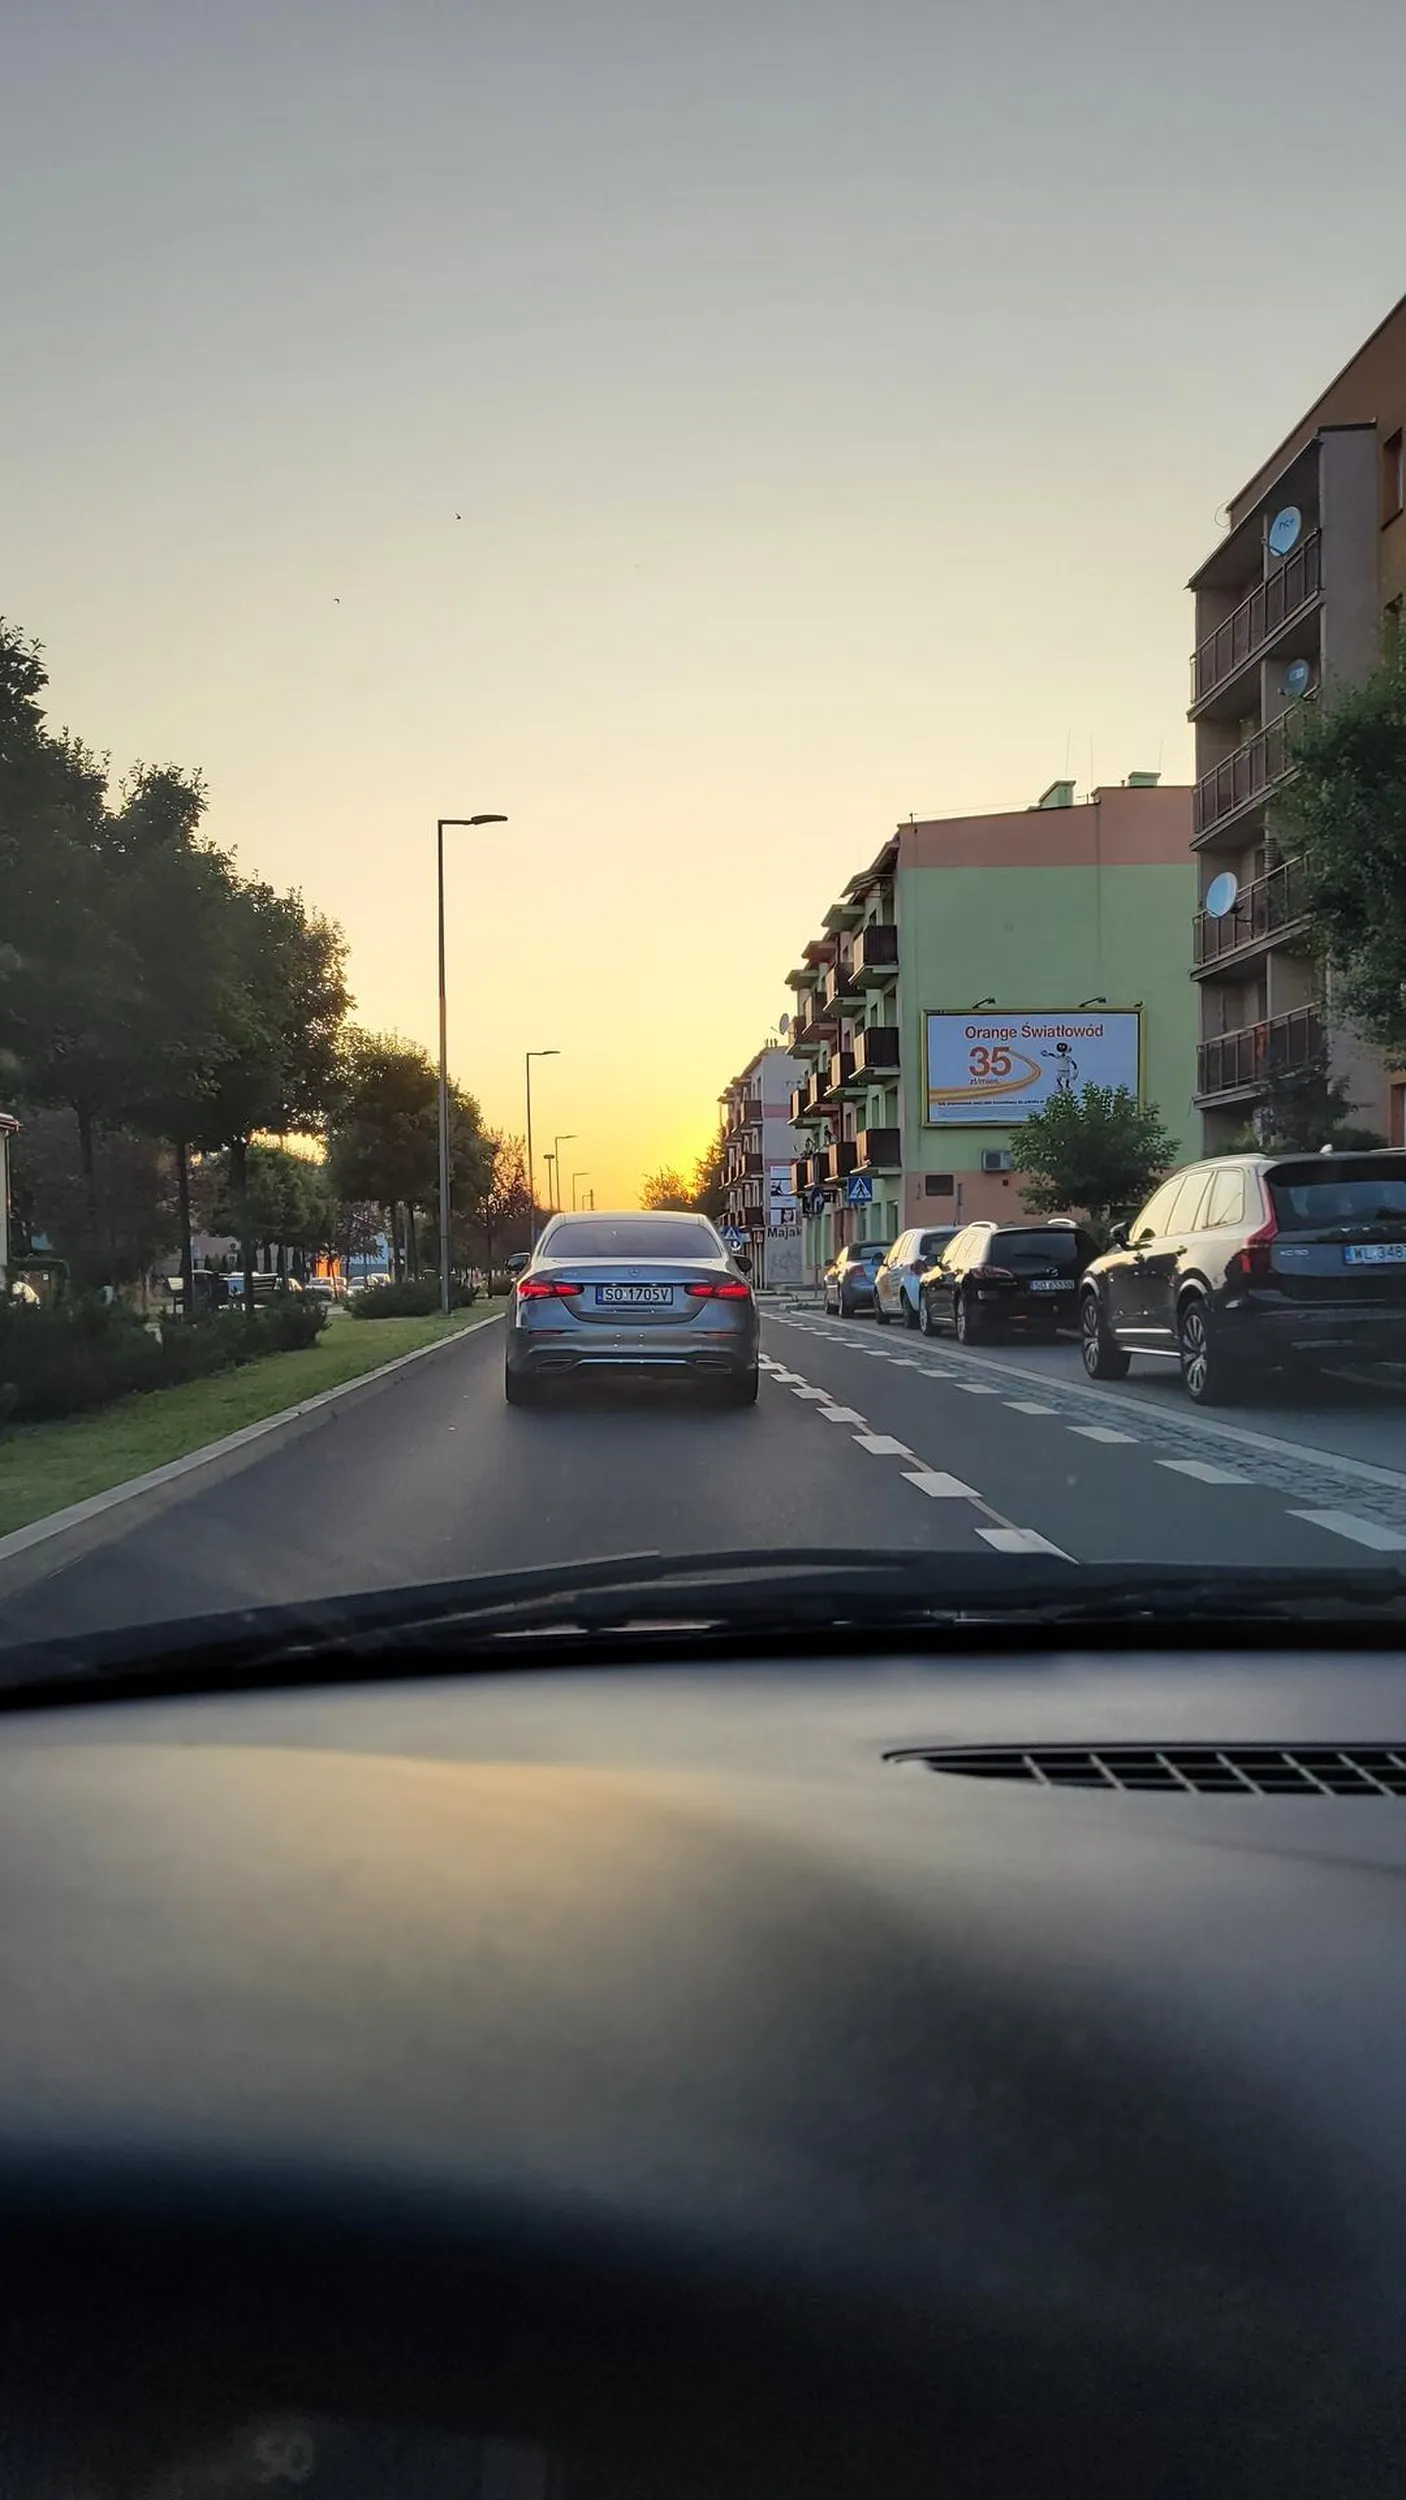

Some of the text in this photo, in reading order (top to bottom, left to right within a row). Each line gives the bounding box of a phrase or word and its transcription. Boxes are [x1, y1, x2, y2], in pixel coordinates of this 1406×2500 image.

[965, 1021, 1103, 1041] Orange Światłowód
[969, 1046, 1012, 1077] 35
[605, 1288, 669, 1301] SO 1705V
